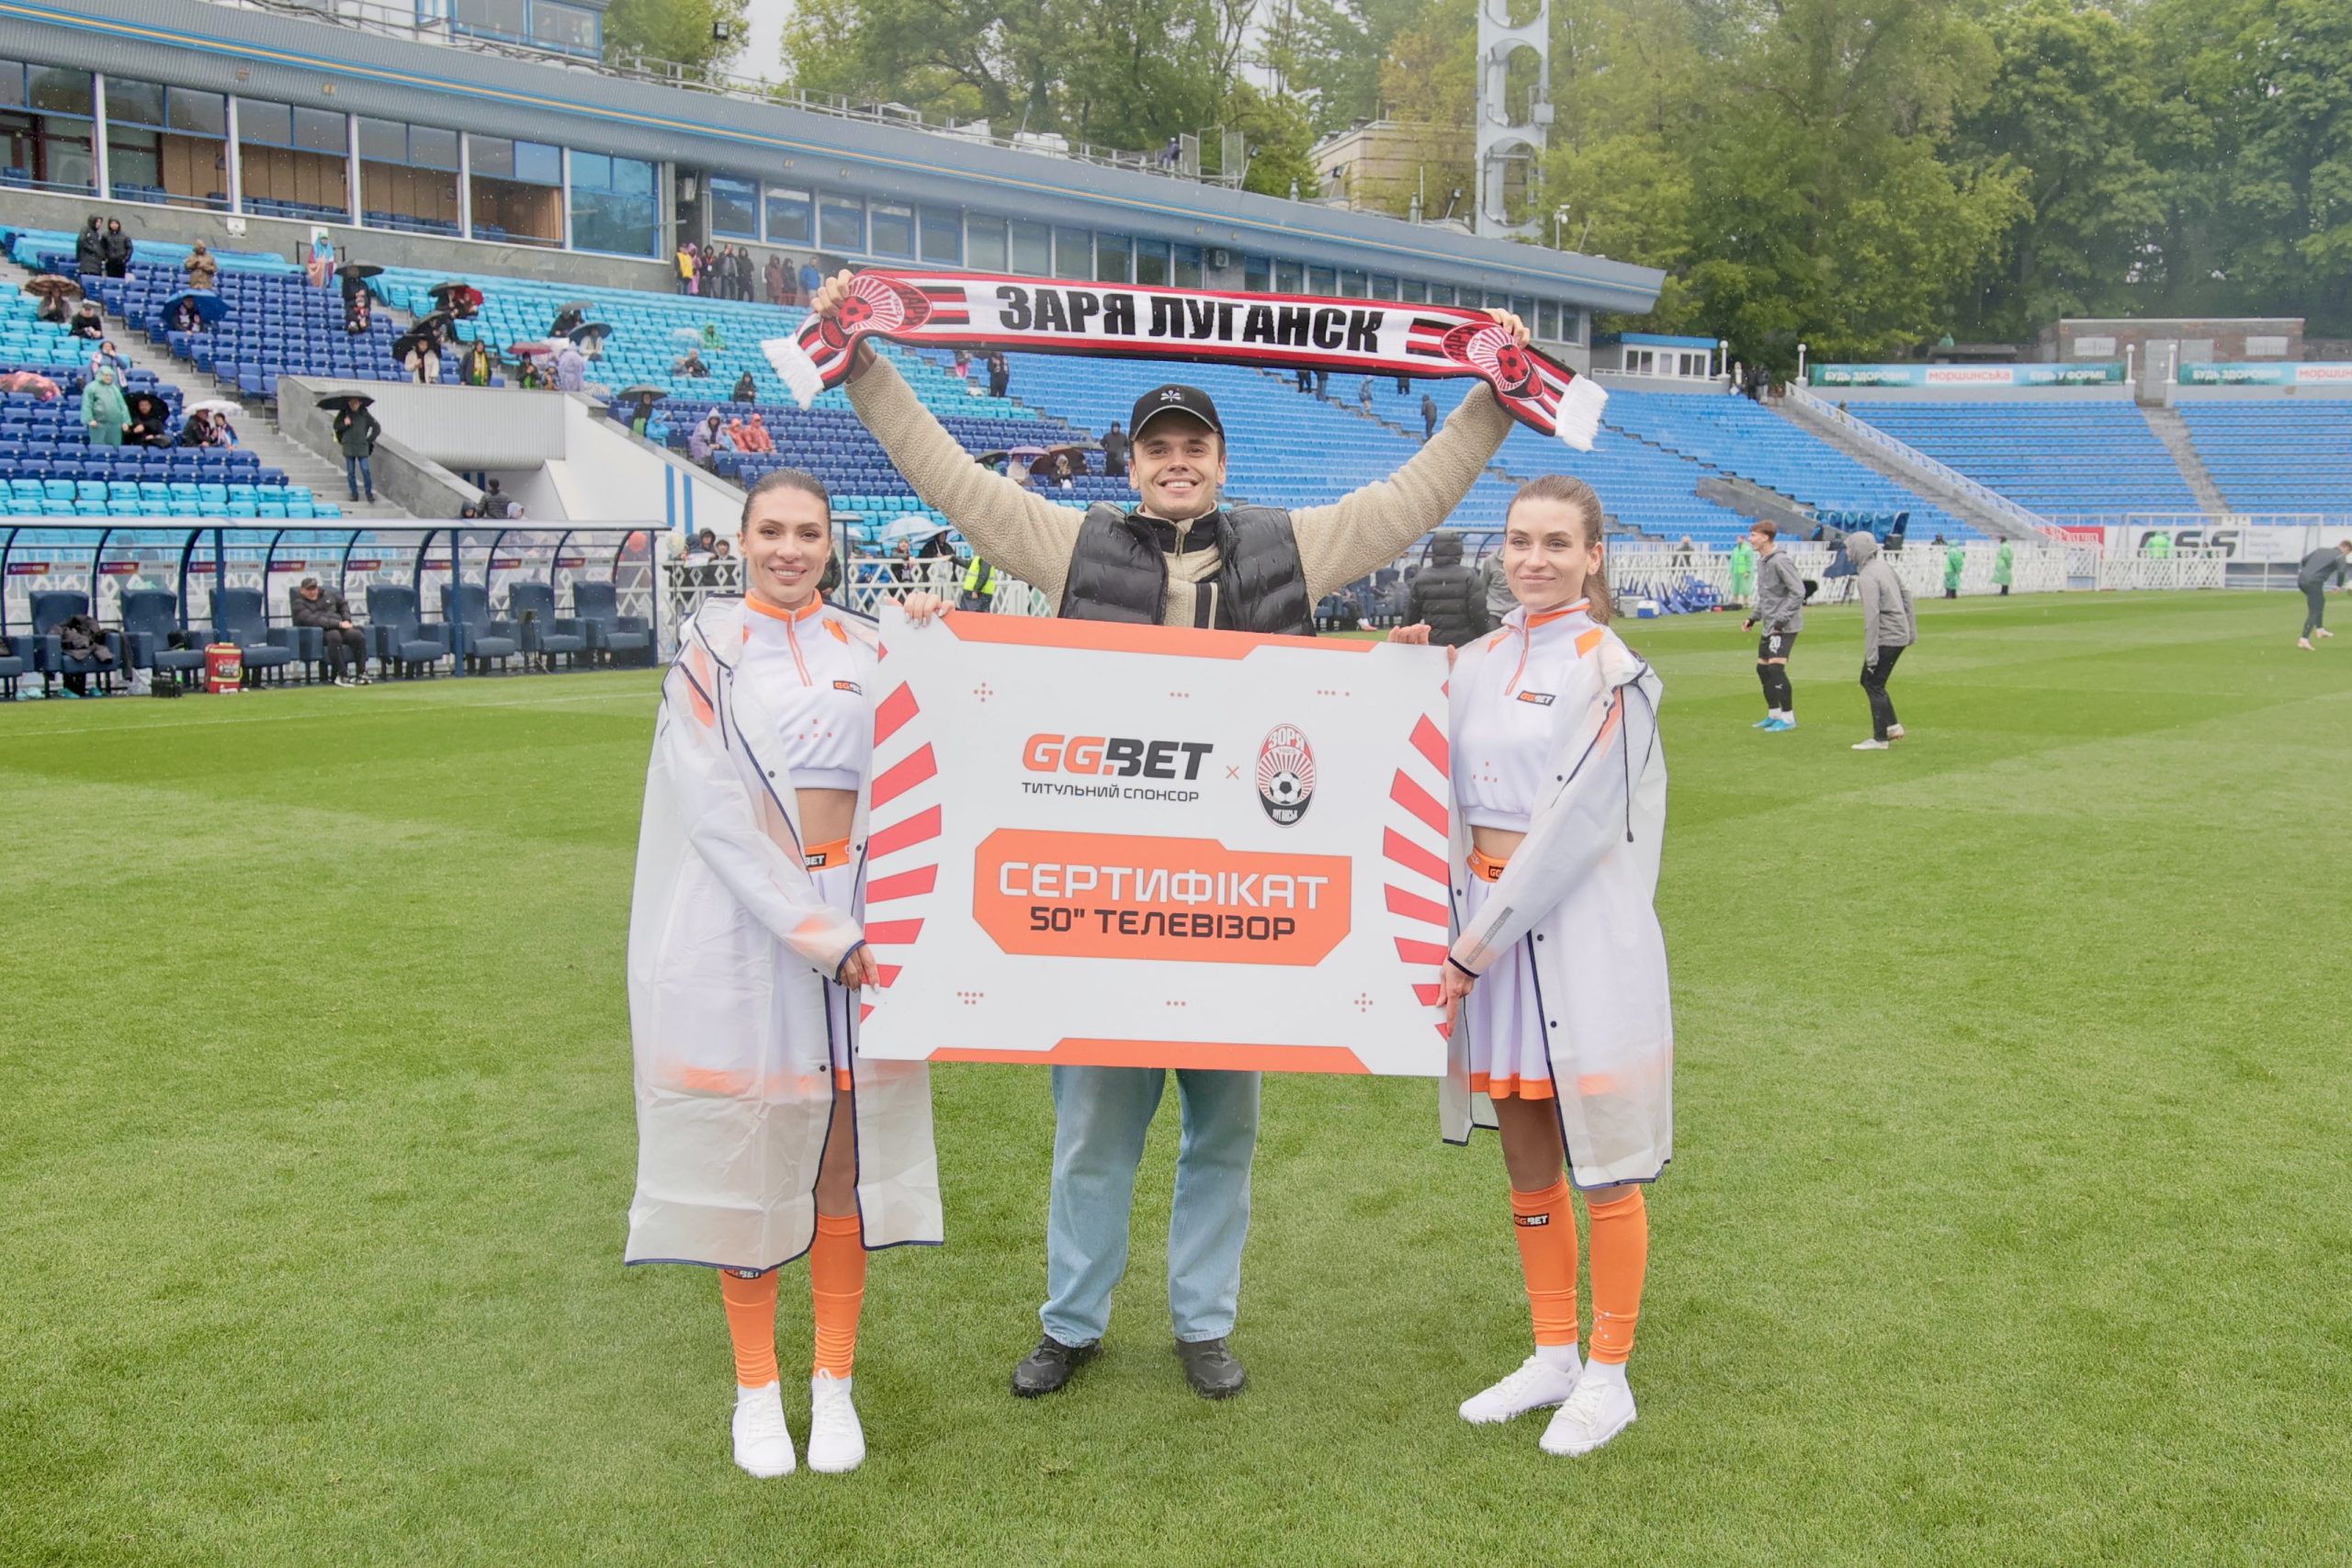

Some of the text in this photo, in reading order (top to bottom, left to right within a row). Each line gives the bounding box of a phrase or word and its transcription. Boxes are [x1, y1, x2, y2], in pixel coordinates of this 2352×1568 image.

[996, 286, 1385, 354] ЗАРЯ ЛУГАНСК
[1769, 635, 1781, 649] 20
[1268, 727, 1305, 751] ЗОРЯ
[1022, 782, 1199, 802] ТИТУЛЬНИЙ СПОНСОР
[999, 861, 1329, 909] СЕРТИФІКАТ
[1030, 906, 1295, 941] 50" ТЕЛЕВІЗОР
